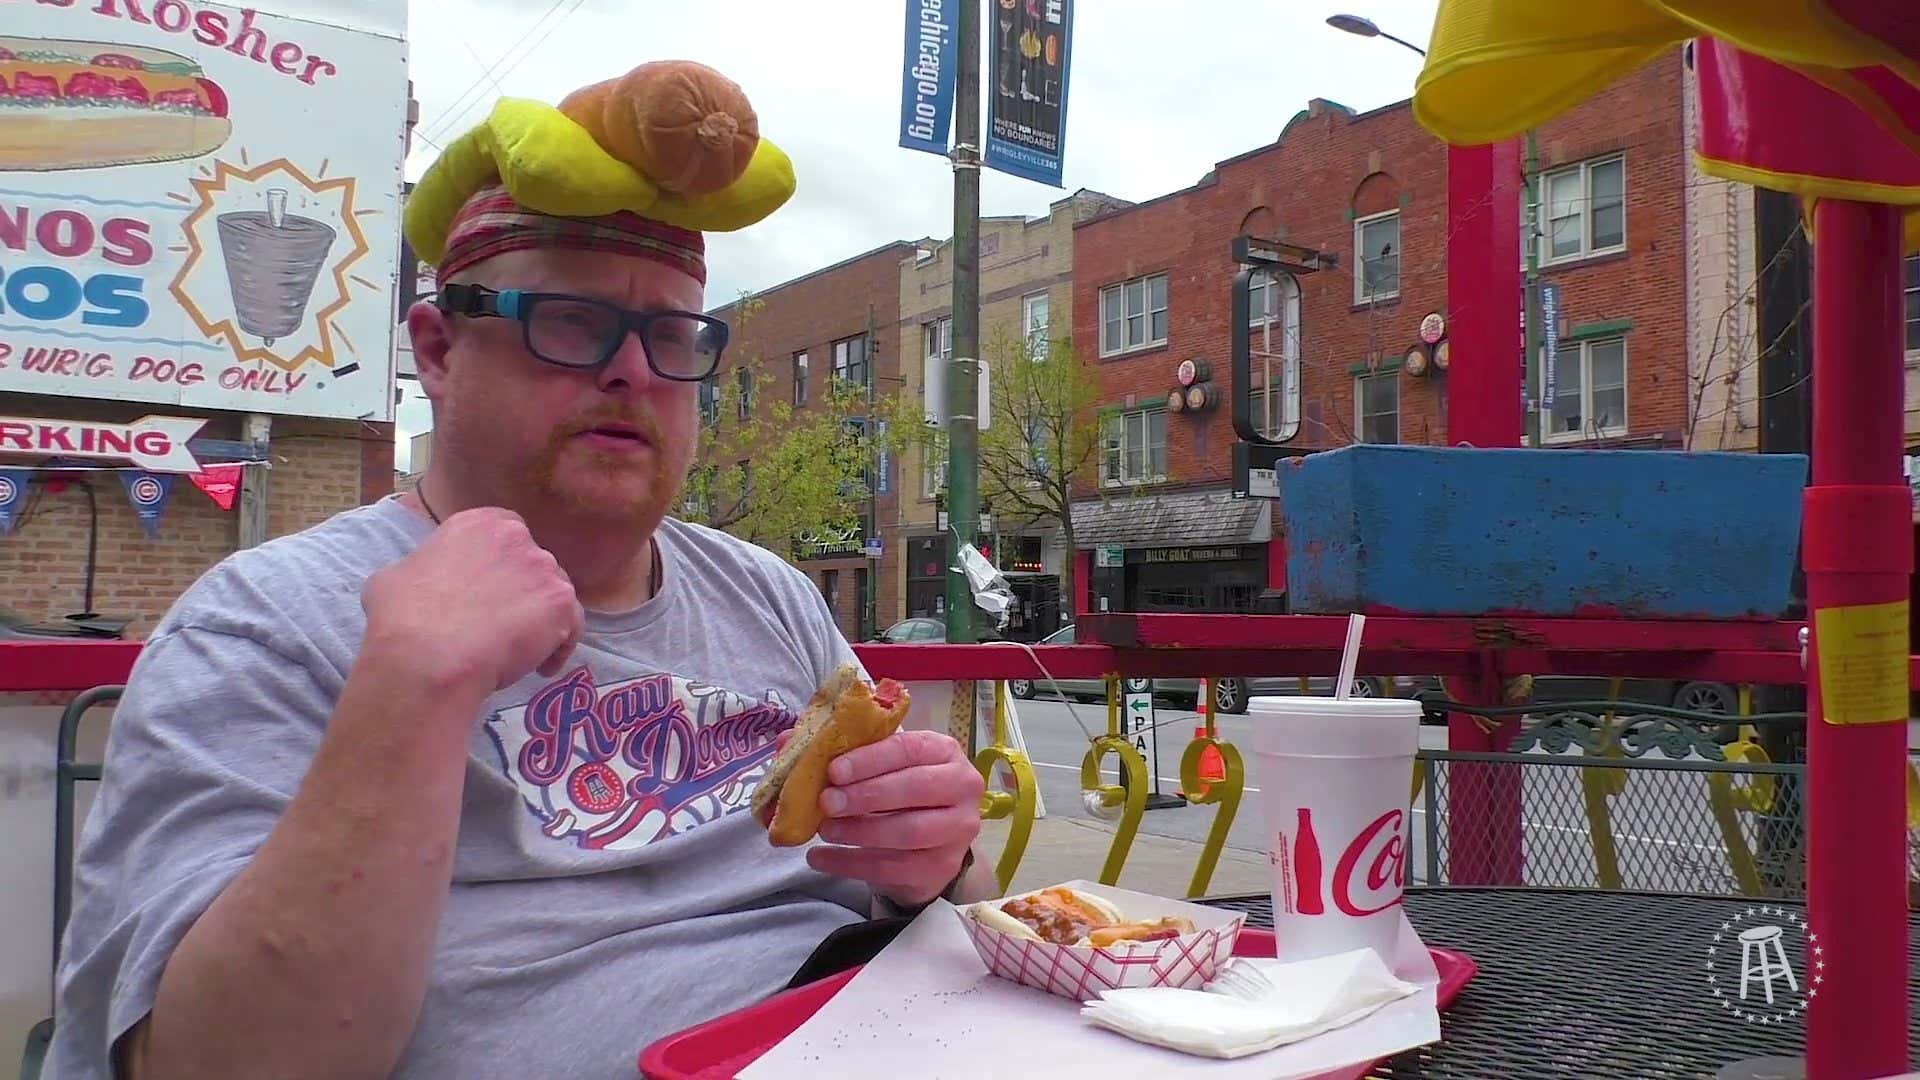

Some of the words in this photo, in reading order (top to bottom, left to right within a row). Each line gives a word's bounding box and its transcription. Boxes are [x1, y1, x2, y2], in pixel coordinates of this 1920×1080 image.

[908, 0, 949, 140] echicago.org
[994, 117, 1017, 130] WHERE
[1032, 129, 1057, 141] KNOWS
[994, 125, 1006, 136] NO
[1007, 129, 1056, 150] BOUNDARIES
[0, 265, 149, 328] OS
[128, 356, 205, 386] DOG
[218, 366, 307, 394] ONLY
[0, 422, 171, 456] RKING
[518, 665, 674, 787] Raw
